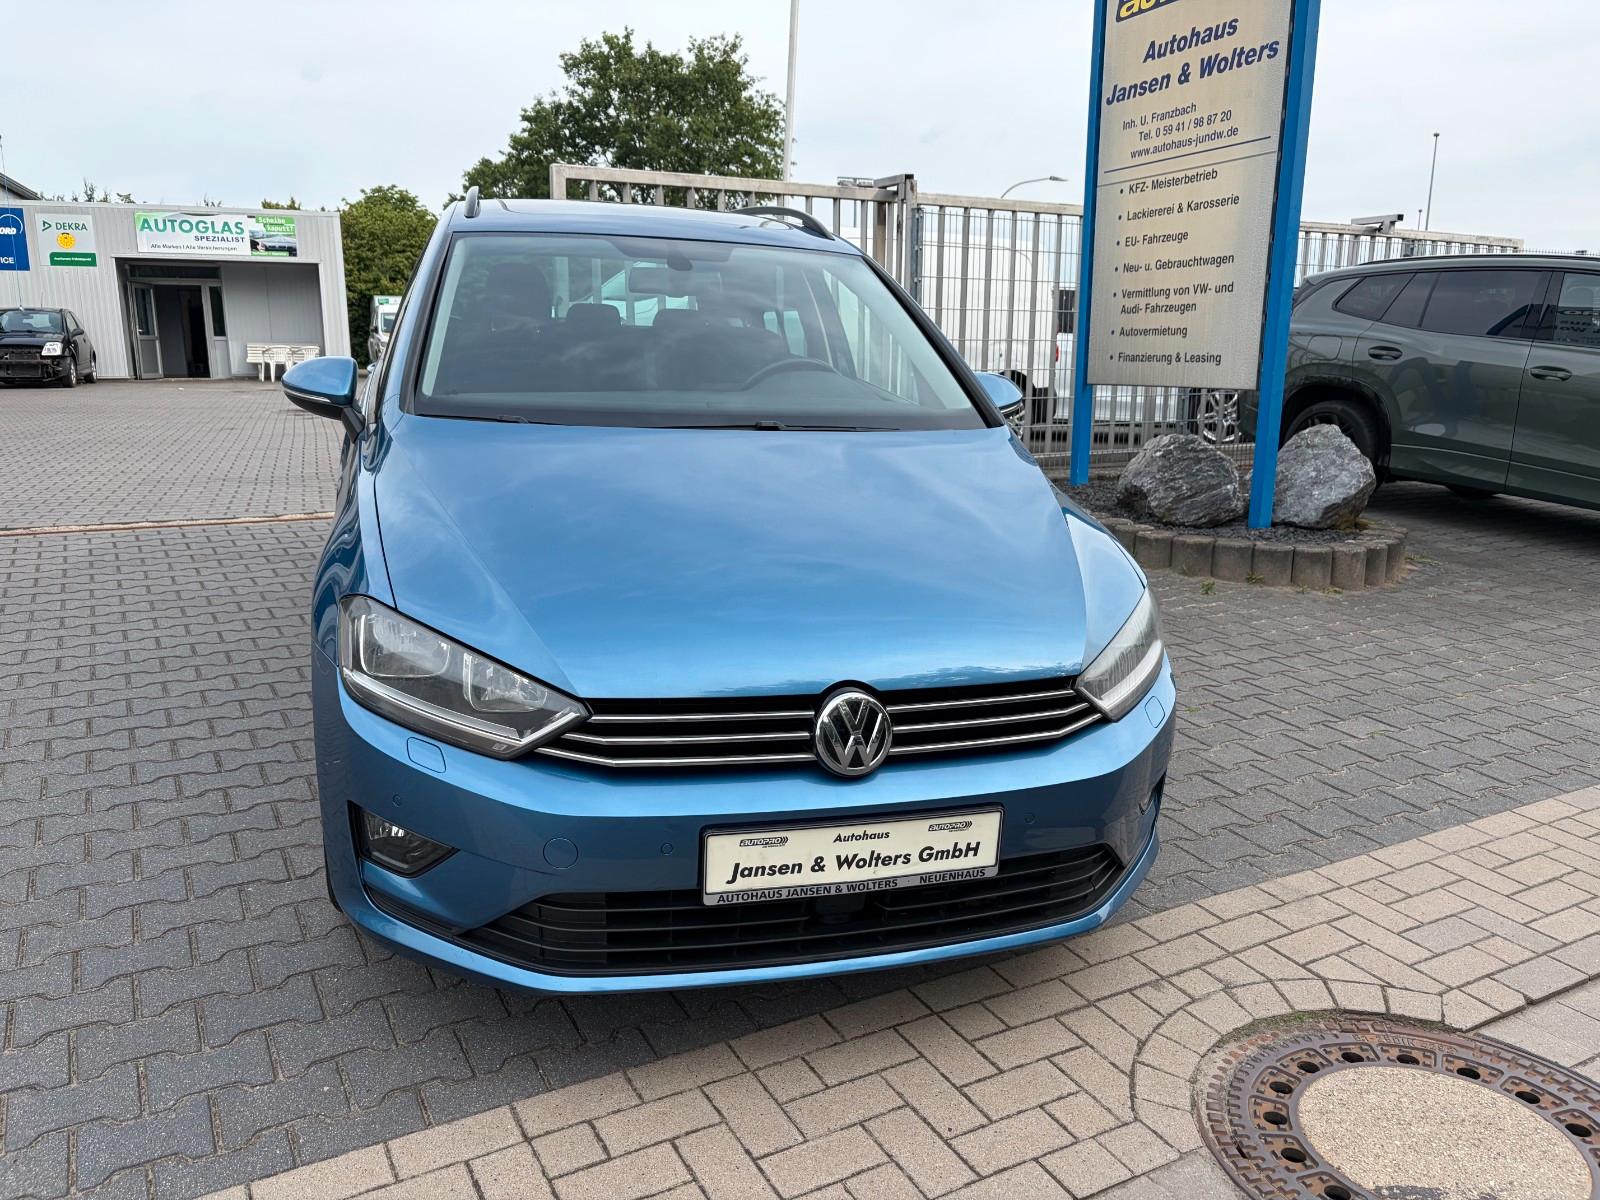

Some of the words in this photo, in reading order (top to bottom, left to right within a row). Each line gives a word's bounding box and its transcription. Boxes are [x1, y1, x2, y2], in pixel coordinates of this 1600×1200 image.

[1143, 18, 1239, 63] Autohaus
[1106, 72, 1171, 106] Jansen
[1178, 62, 1191, 85] &
[1200, 40, 1280, 79] Wolters
[1122, 118, 1138, 131] Inh.
[1140, 113, 1149, 126] U.
[1151, 102, 1197, 124] Franzbach
[1138, 129, 1153, 142] Tel.
[1155, 127, 1161, 138] 0
[1162, 124, 1174, 137] 59
[1175, 120, 1185, 132] 41
[1193, 116, 1204, 129] 98
[1206, 113, 1218, 125] 87
[1220, 110, 1232, 122] 20
[1130, 126, 1239, 159] www.autohaus-jundw.de
[1151, 168, 1218, 191] Meisterbetrieb
[1126, 203, 1175, 221] Lackiererei
[1177, 202, 1184, 213] &
[1186, 194, 1240, 212] Karosserie
[55, 222, 88, 231] DEKRA
[140, 218, 245, 235] AUTOGLAS
[194, 235, 245, 243] SPEZIALIST
[1142, 231, 1189, 245] Fahrzeuge
[1123, 262, 1143, 273] Neu-
[1144, 263, 1152, 272] u.
[1155, 254, 1235, 271] Gebrauchtwagen
[1121, 286, 1171, 299] Vermittlung
[1173, 286, 1190, 296] von
[1192, 284, 1212, 295] VW-
[1214, 281, 1234, 294] und
[1144, 302, 1197, 315] Fahrzeugen
[1119, 326, 1188, 338] Autovermietung
[1118, 351, 1172, 364] Finanzierung
[1175, 352, 1181, 363] &
[1184, 352, 1222, 365] Leasing
[821, 698, 887, 771] VW
[833, 830, 890, 843] Autohaus
[726, 861, 803, 884] Jansen
[810, 855, 826, 873] &
[835, 849, 911, 872] Wolters
[918, 841, 981, 863] GmbH
[717, 889, 783, 904] AUTOHAUS
[785, 884, 832, 899] JANSEN
[834, 884, 843, 894] &
[846, 878, 898, 893] WOLTERS
[919, 868, 986, 884] NEUENHAUS
